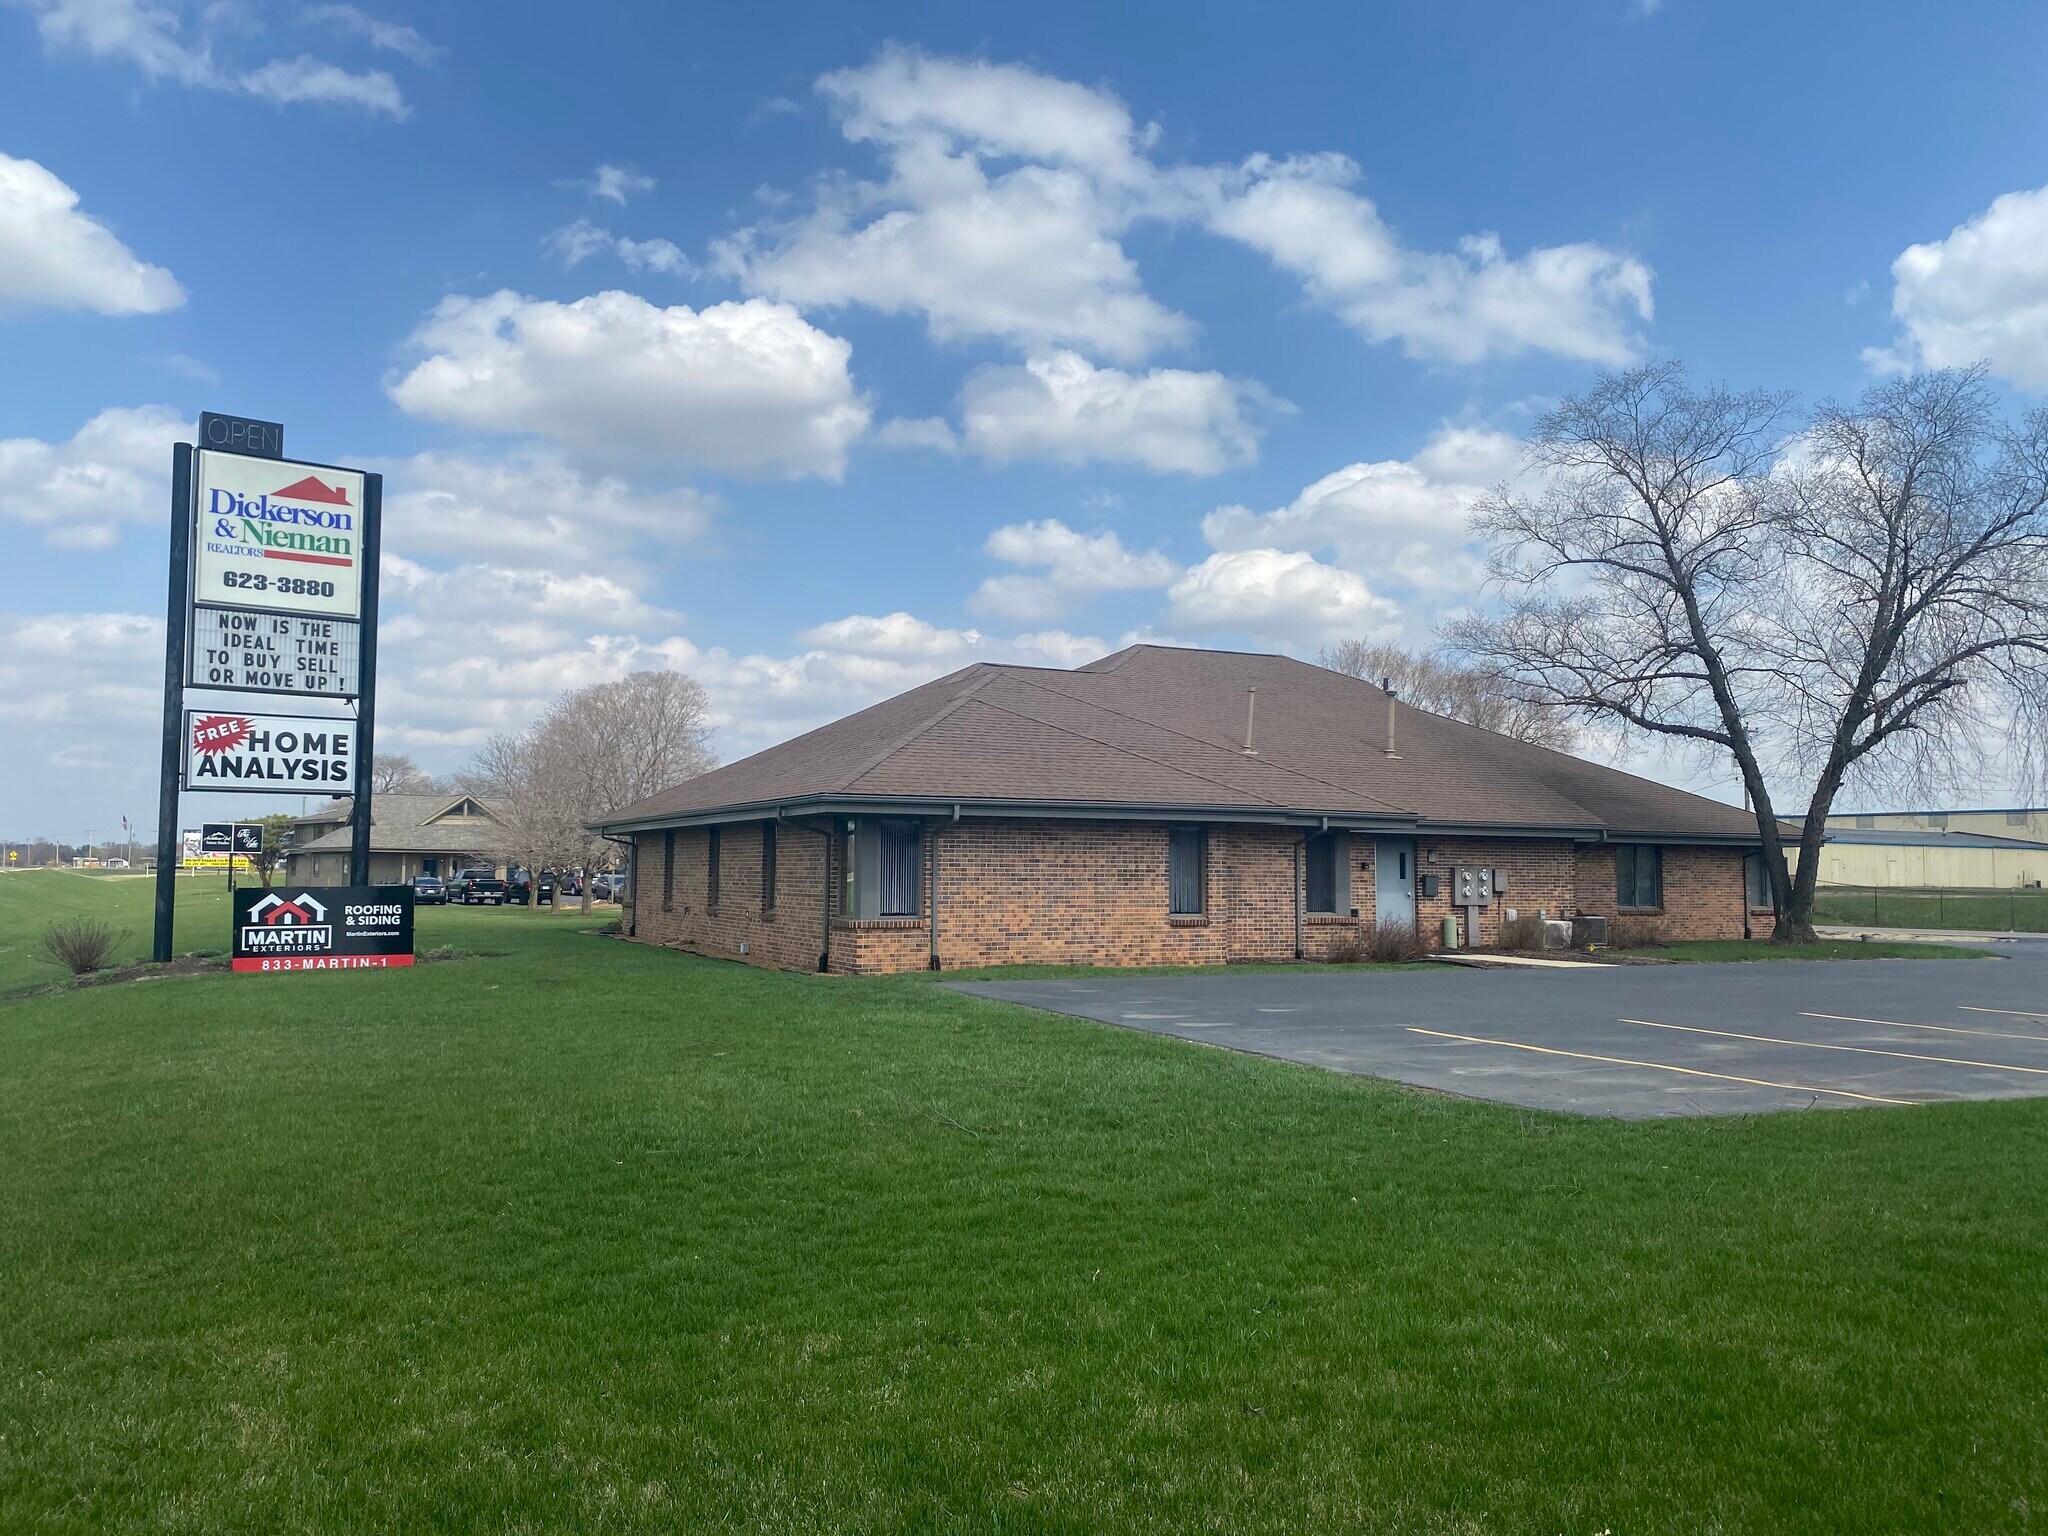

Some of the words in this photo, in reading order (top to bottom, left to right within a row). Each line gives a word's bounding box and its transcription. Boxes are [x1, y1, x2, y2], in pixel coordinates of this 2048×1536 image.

[208, 418, 279, 452] OPEN
[209, 488, 353, 530] Dickerson
[215, 518, 238, 539] &
[240, 518, 352, 555] Nieman
[207, 542, 264, 557] REALTORS
[223, 571, 334, 597] 623-3880
[219, 614, 257, 631] NOW
[273, 619, 289, 634] IS
[301, 622, 331, 638] THE
[223, 633, 275, 651] IDEAL
[296, 639, 338, 656] TIME
[207, 649, 229, 664] TO
[244, 653, 280, 668] BUY
[297, 657, 338, 673] SELL
[209, 668, 234, 683] OR
[246, 671, 293, 687] MOVE
[305, 676, 327, 690] UP
[195, 720, 241, 744] FREE
[249, 730, 348, 756] HOME
[197, 755, 348, 781] ANALYSIS
[345, 905, 402, 915] ROOFING
[346, 917, 356, 926] &
[357, 915, 400, 925] SIDING
[249, 930, 325, 945] MARTIN
[262, 958, 387, 970] 833-MARTIN-1
